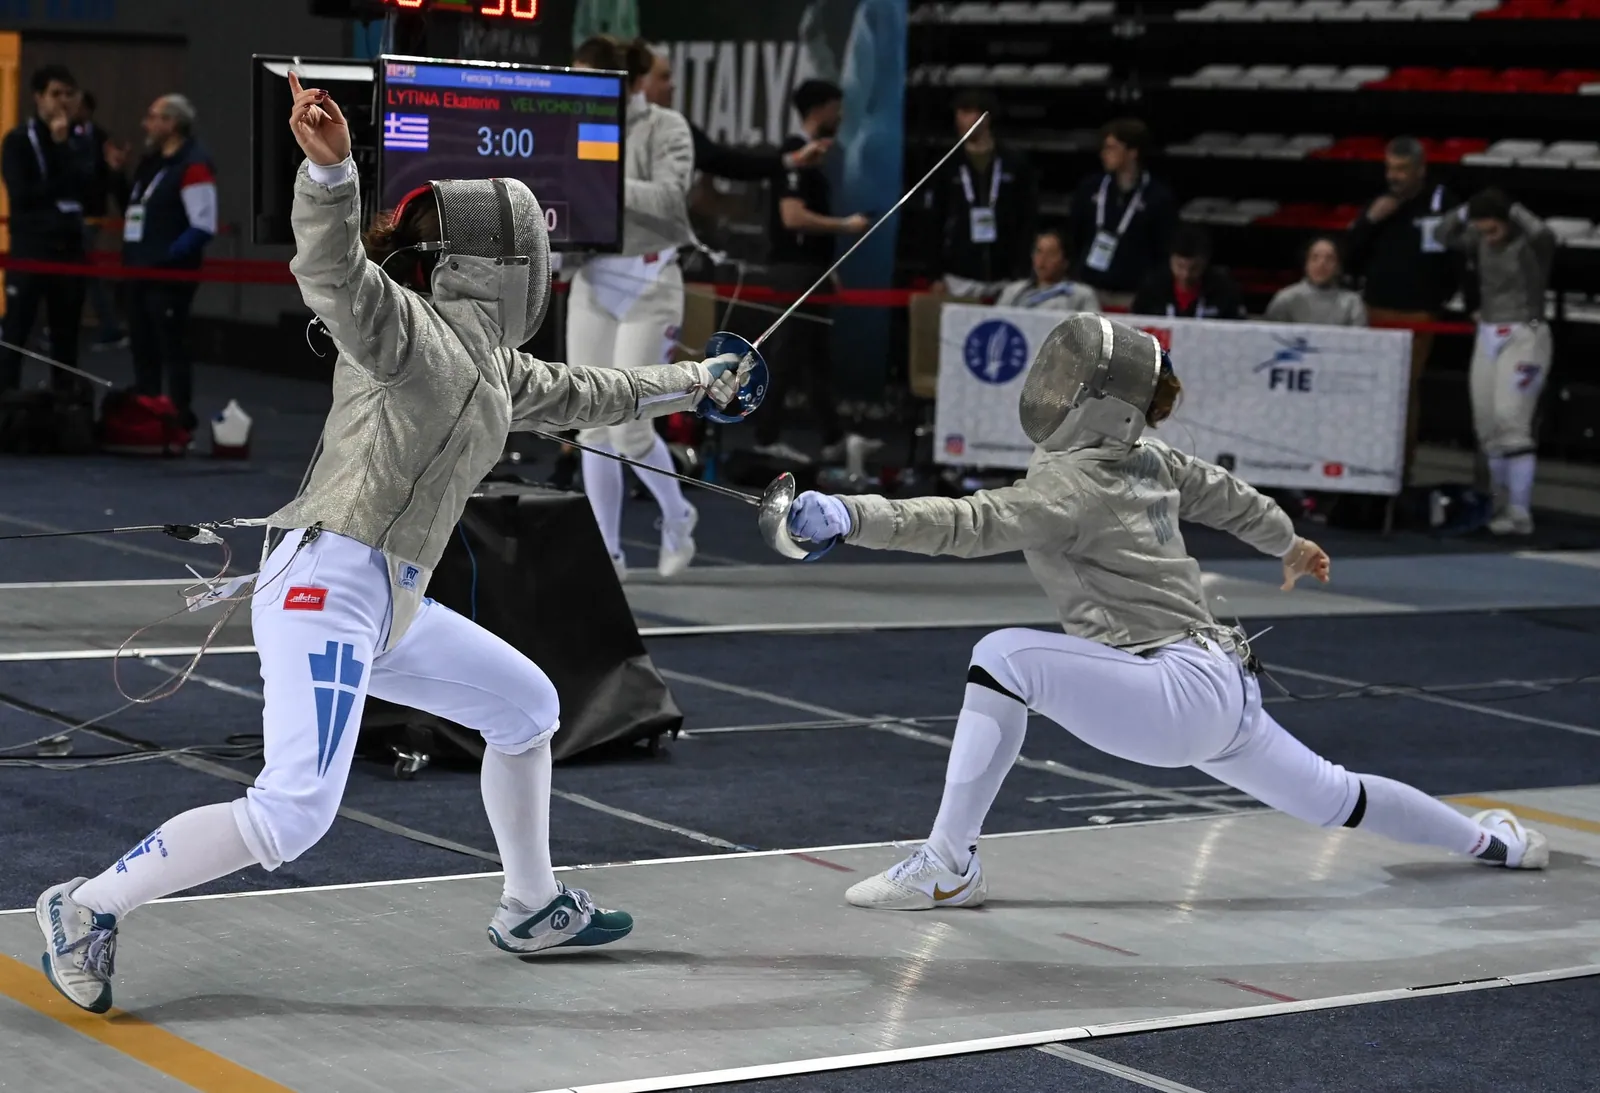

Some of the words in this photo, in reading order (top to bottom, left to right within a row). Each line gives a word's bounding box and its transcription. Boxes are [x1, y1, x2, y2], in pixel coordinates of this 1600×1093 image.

[477, 126, 534, 158] 3:00
[1268, 367, 1313, 392] FIE
[288, 593, 321, 604] allstar
